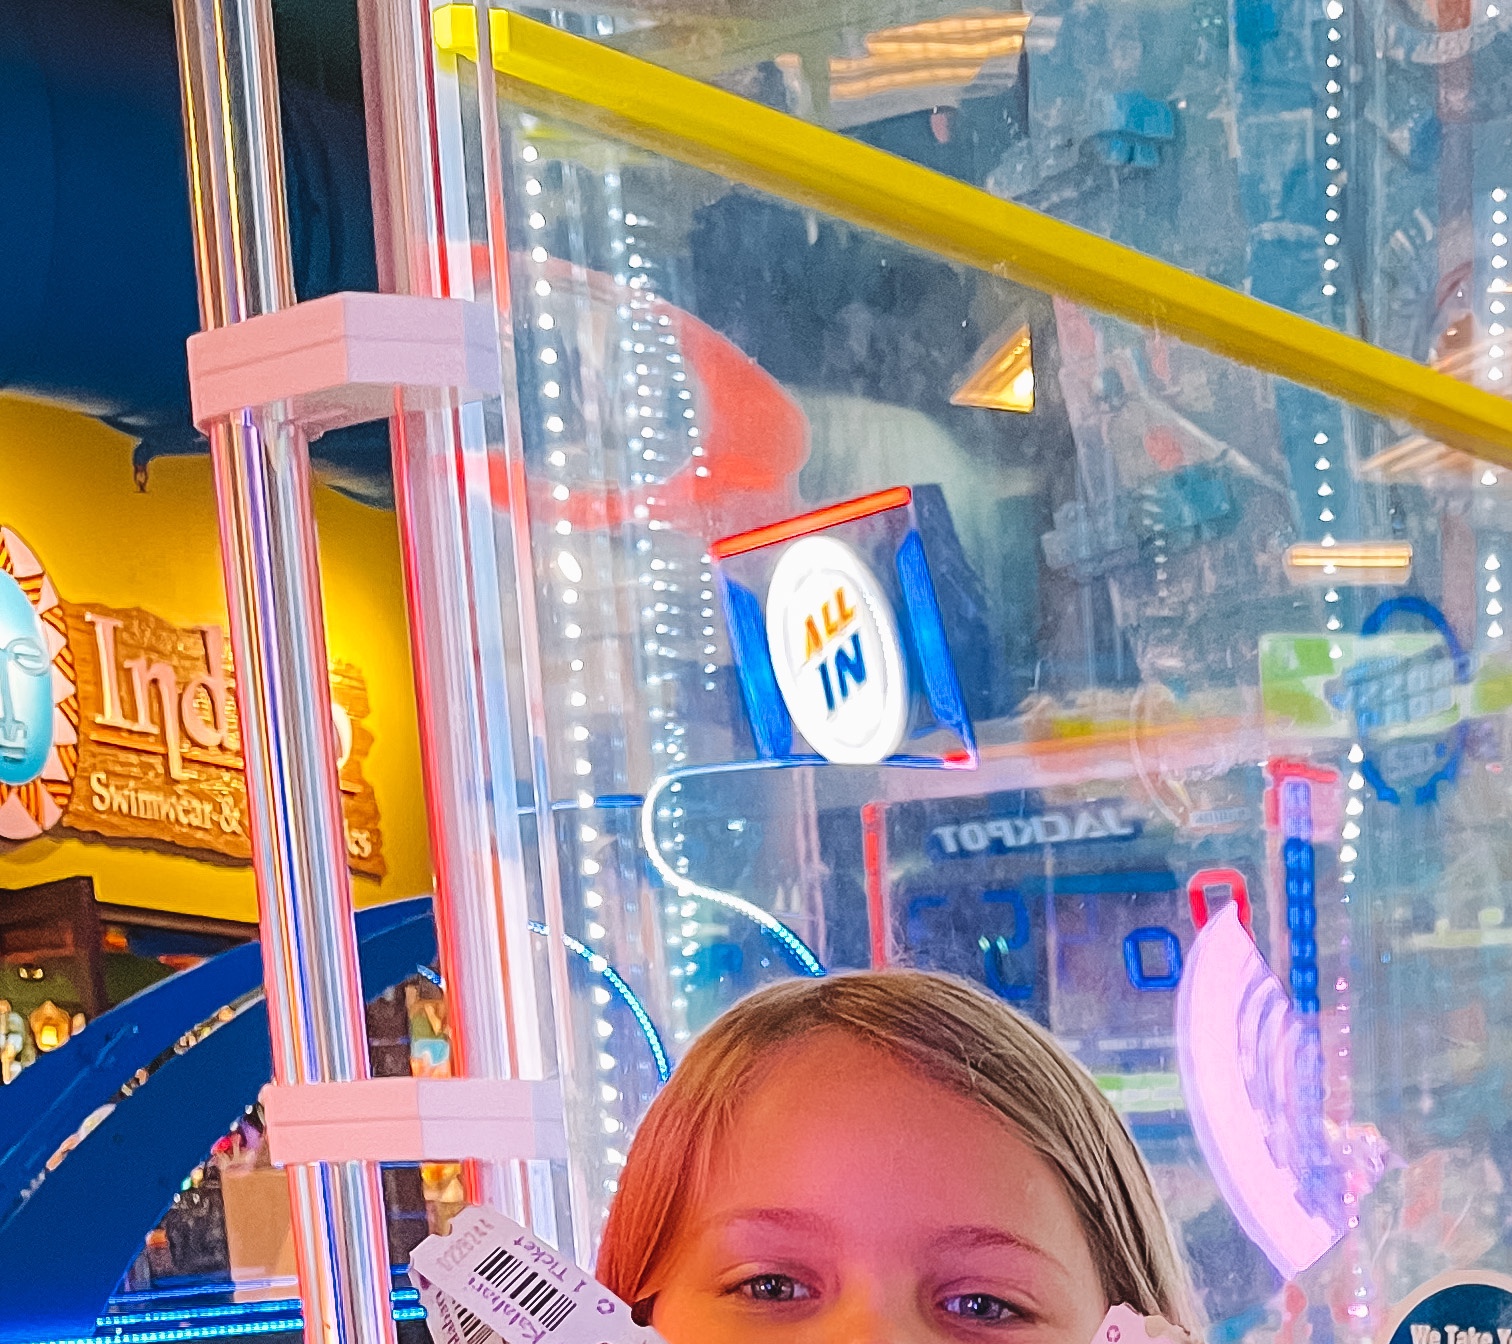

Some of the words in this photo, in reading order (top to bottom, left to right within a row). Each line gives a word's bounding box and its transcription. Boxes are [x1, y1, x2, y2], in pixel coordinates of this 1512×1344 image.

[804, 587, 857, 660] ALL
[817, 633, 868, 711] IN
[513, 1234, 570, 1278] Ticket
[573, 1279, 588, 1294] 1
[467, 1276, 546, 1344] Kalahari
